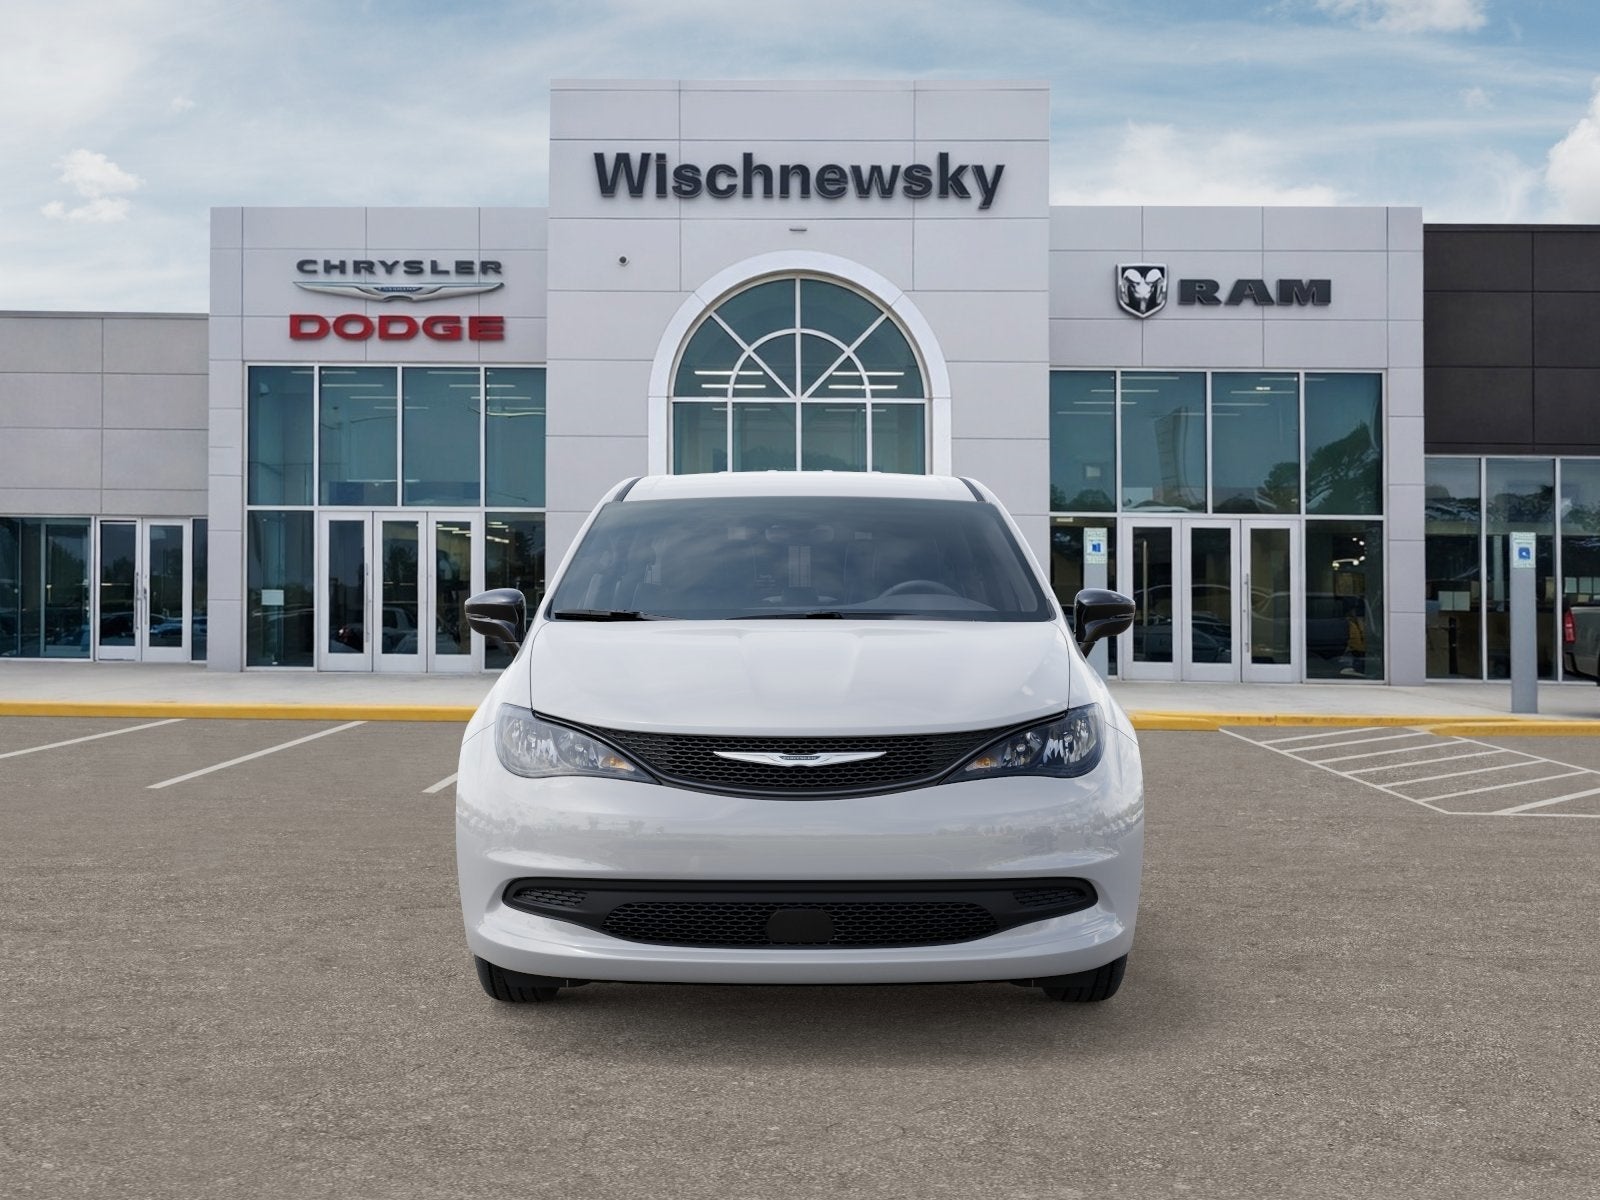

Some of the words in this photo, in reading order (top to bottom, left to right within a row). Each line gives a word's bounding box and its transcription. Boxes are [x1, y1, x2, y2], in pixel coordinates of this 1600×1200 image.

[593, 152, 1006, 210] Wischnewsky
[296, 259, 503, 275] CHRYSLER
[1178, 279, 1332, 306] RAM
[289, 314, 505, 341] DODGE
